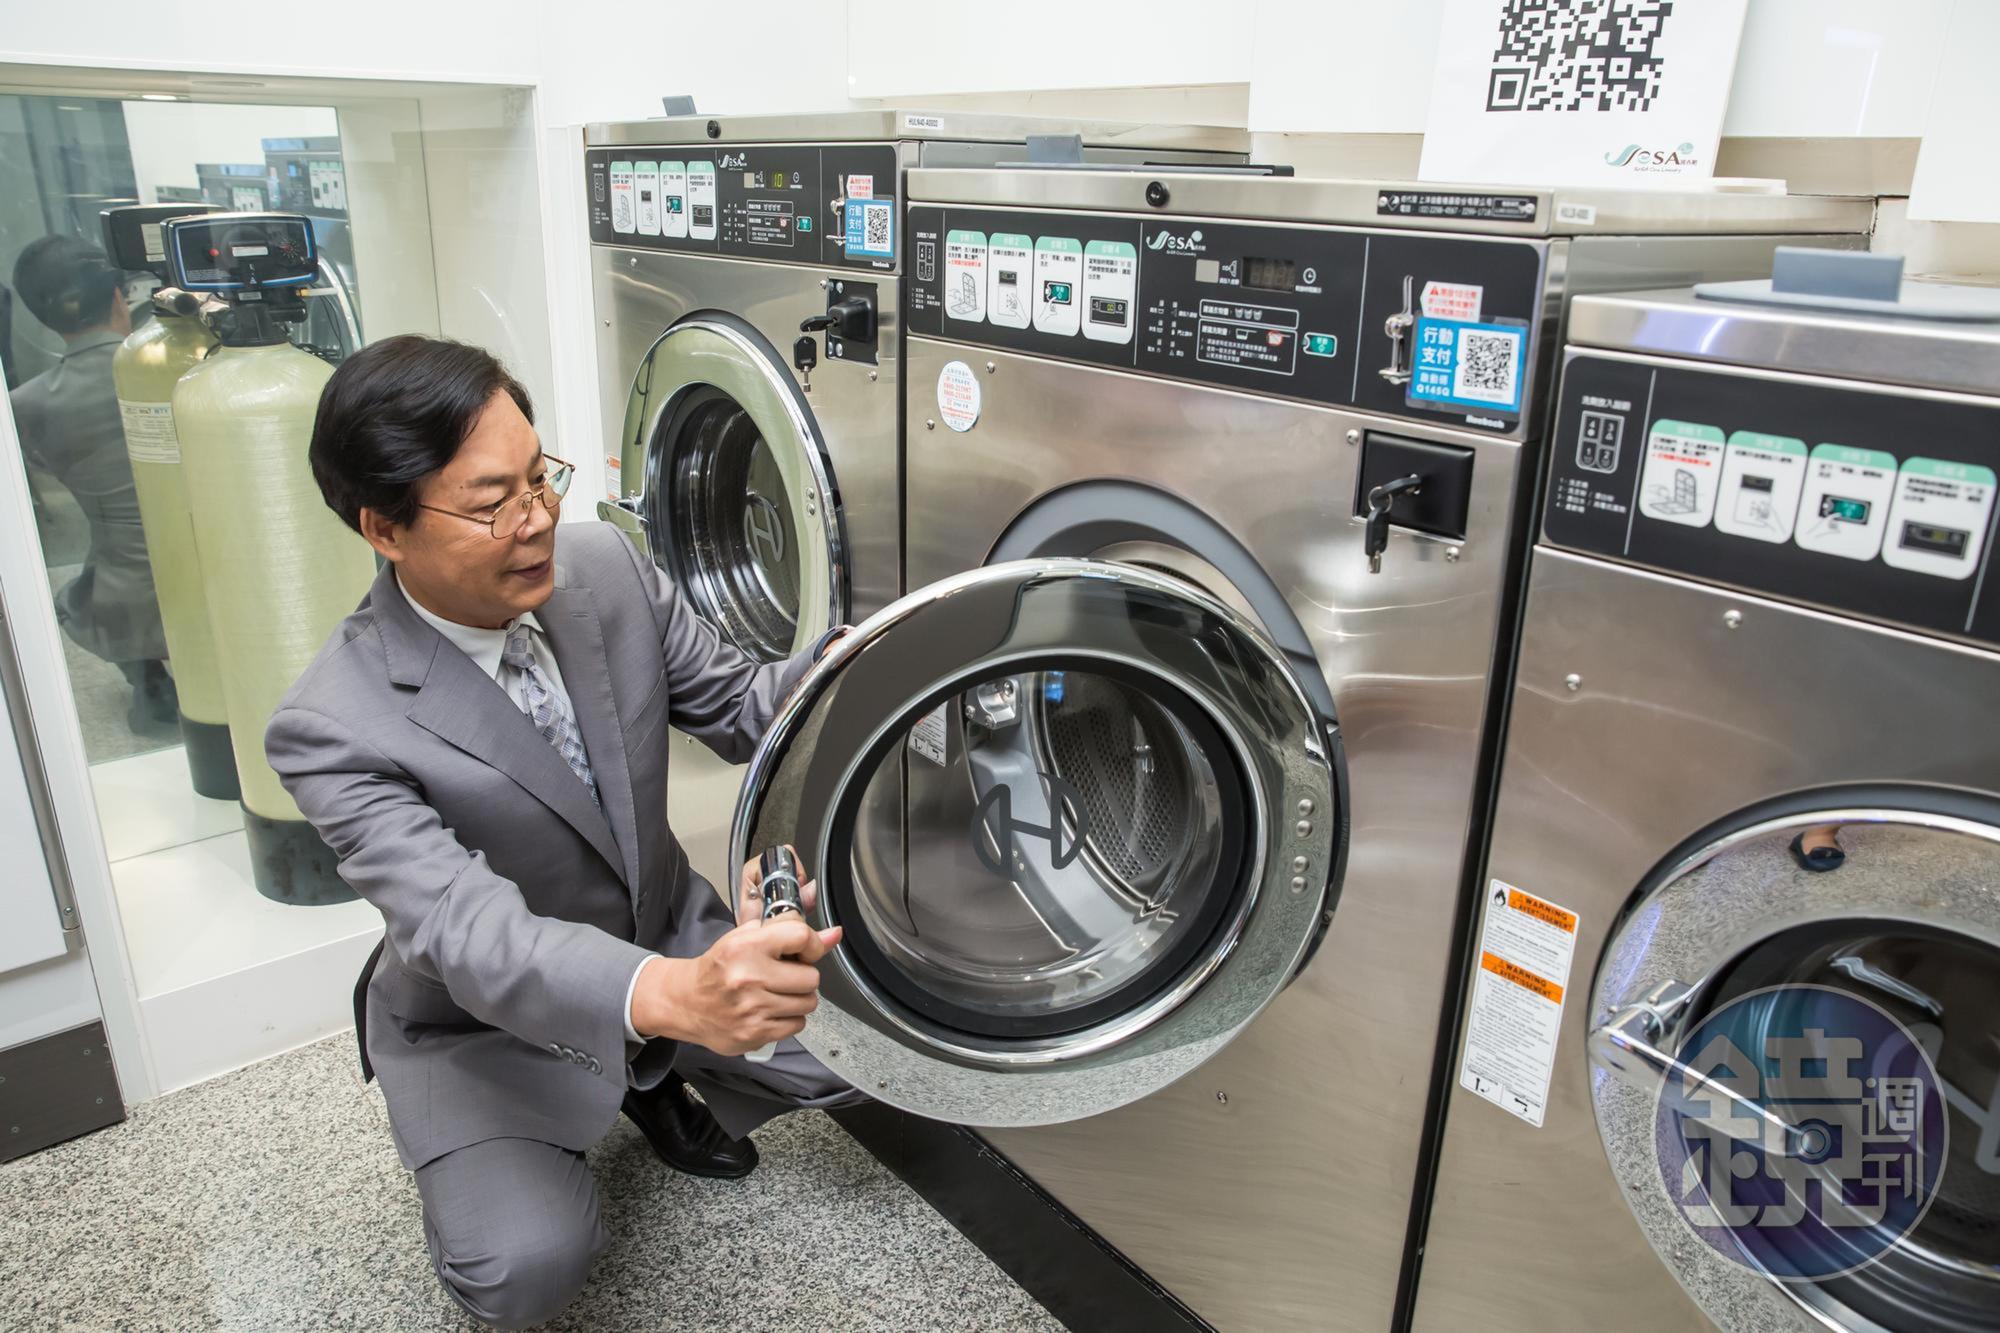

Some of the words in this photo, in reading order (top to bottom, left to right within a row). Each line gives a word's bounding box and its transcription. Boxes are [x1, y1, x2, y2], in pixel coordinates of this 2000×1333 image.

[1423, 326, 1454, 346] 行動
[1421, 346, 1452, 365] 支付
[1525, 897, 1568, 921] WARNING
[1506, 961, 1548, 988] WARNING
